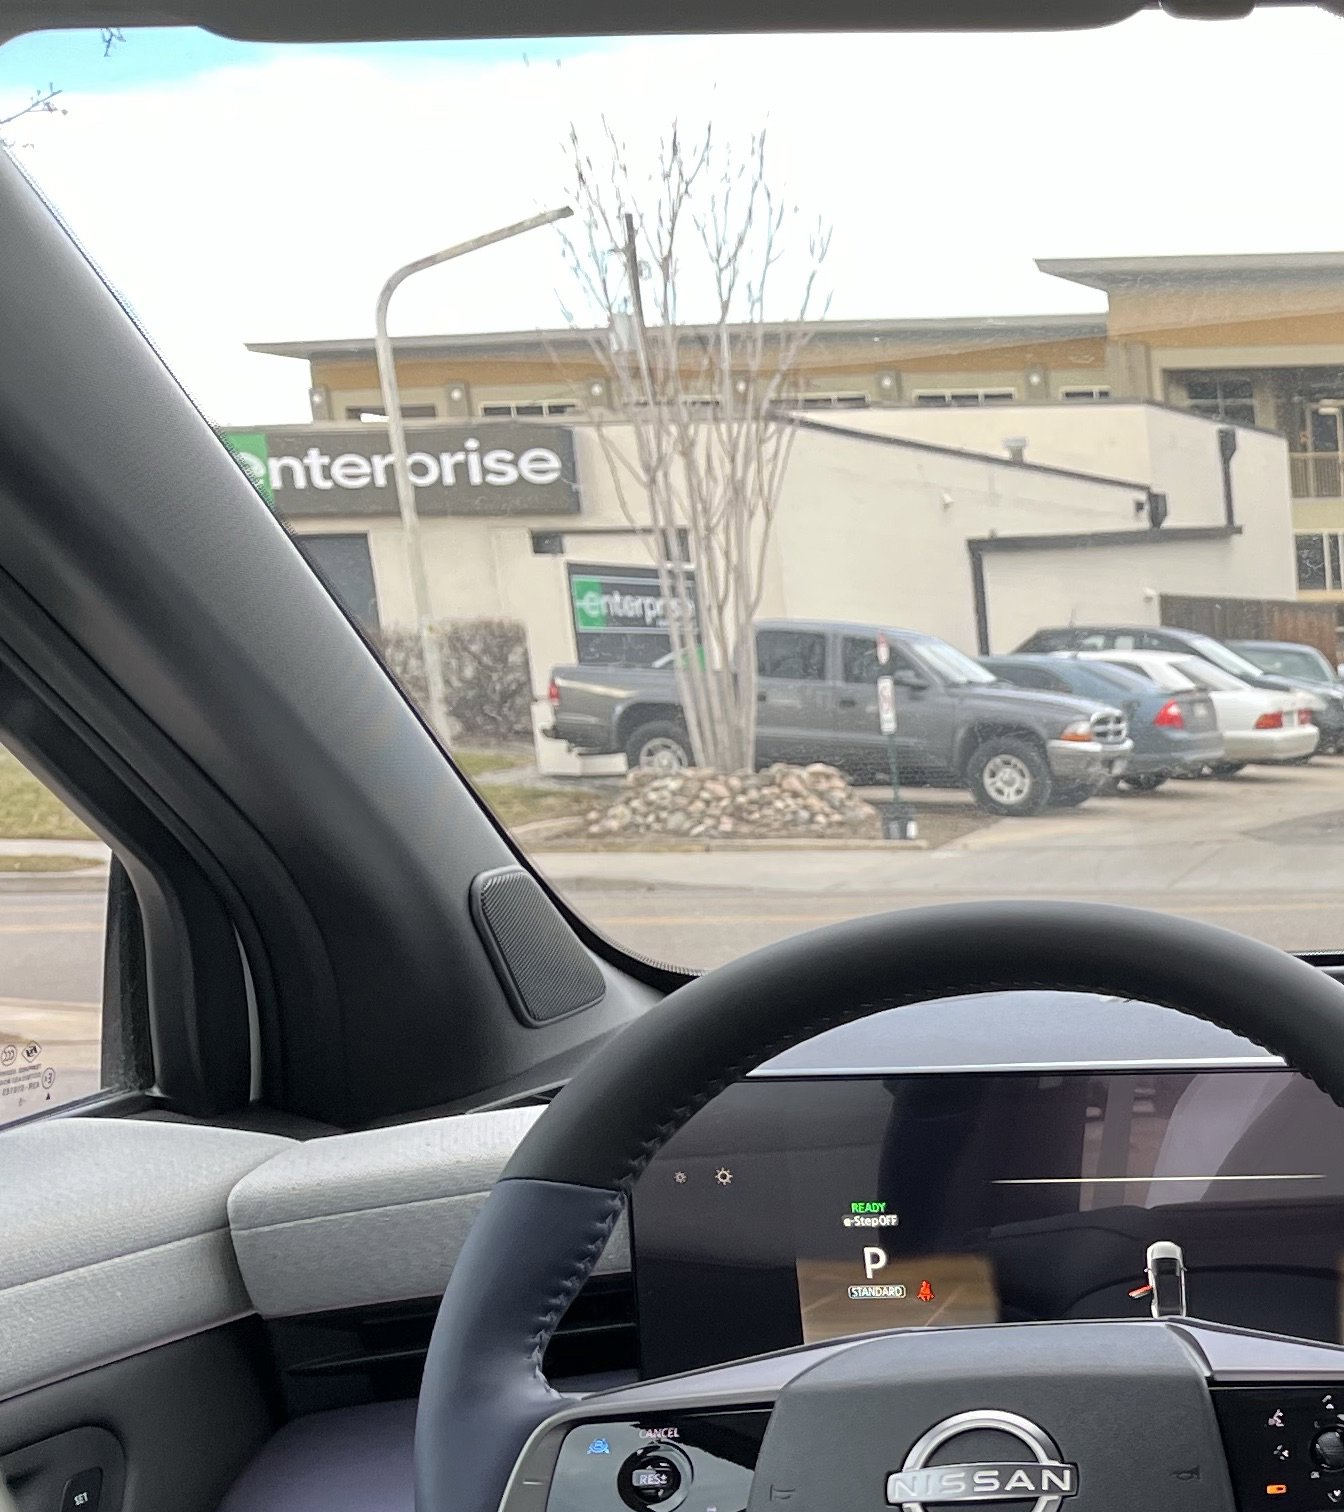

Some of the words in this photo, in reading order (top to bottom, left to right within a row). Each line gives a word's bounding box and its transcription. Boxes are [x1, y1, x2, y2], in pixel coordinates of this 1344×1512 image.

[851, 1202, 887, 1213] READY
[863, 1246, 887, 1279] P
[850, 1286, 903, 1298] STANDARD
[639, 1427, 680, 1440] CANCEL
[894, 1469, 1071, 1499] NISSAN
